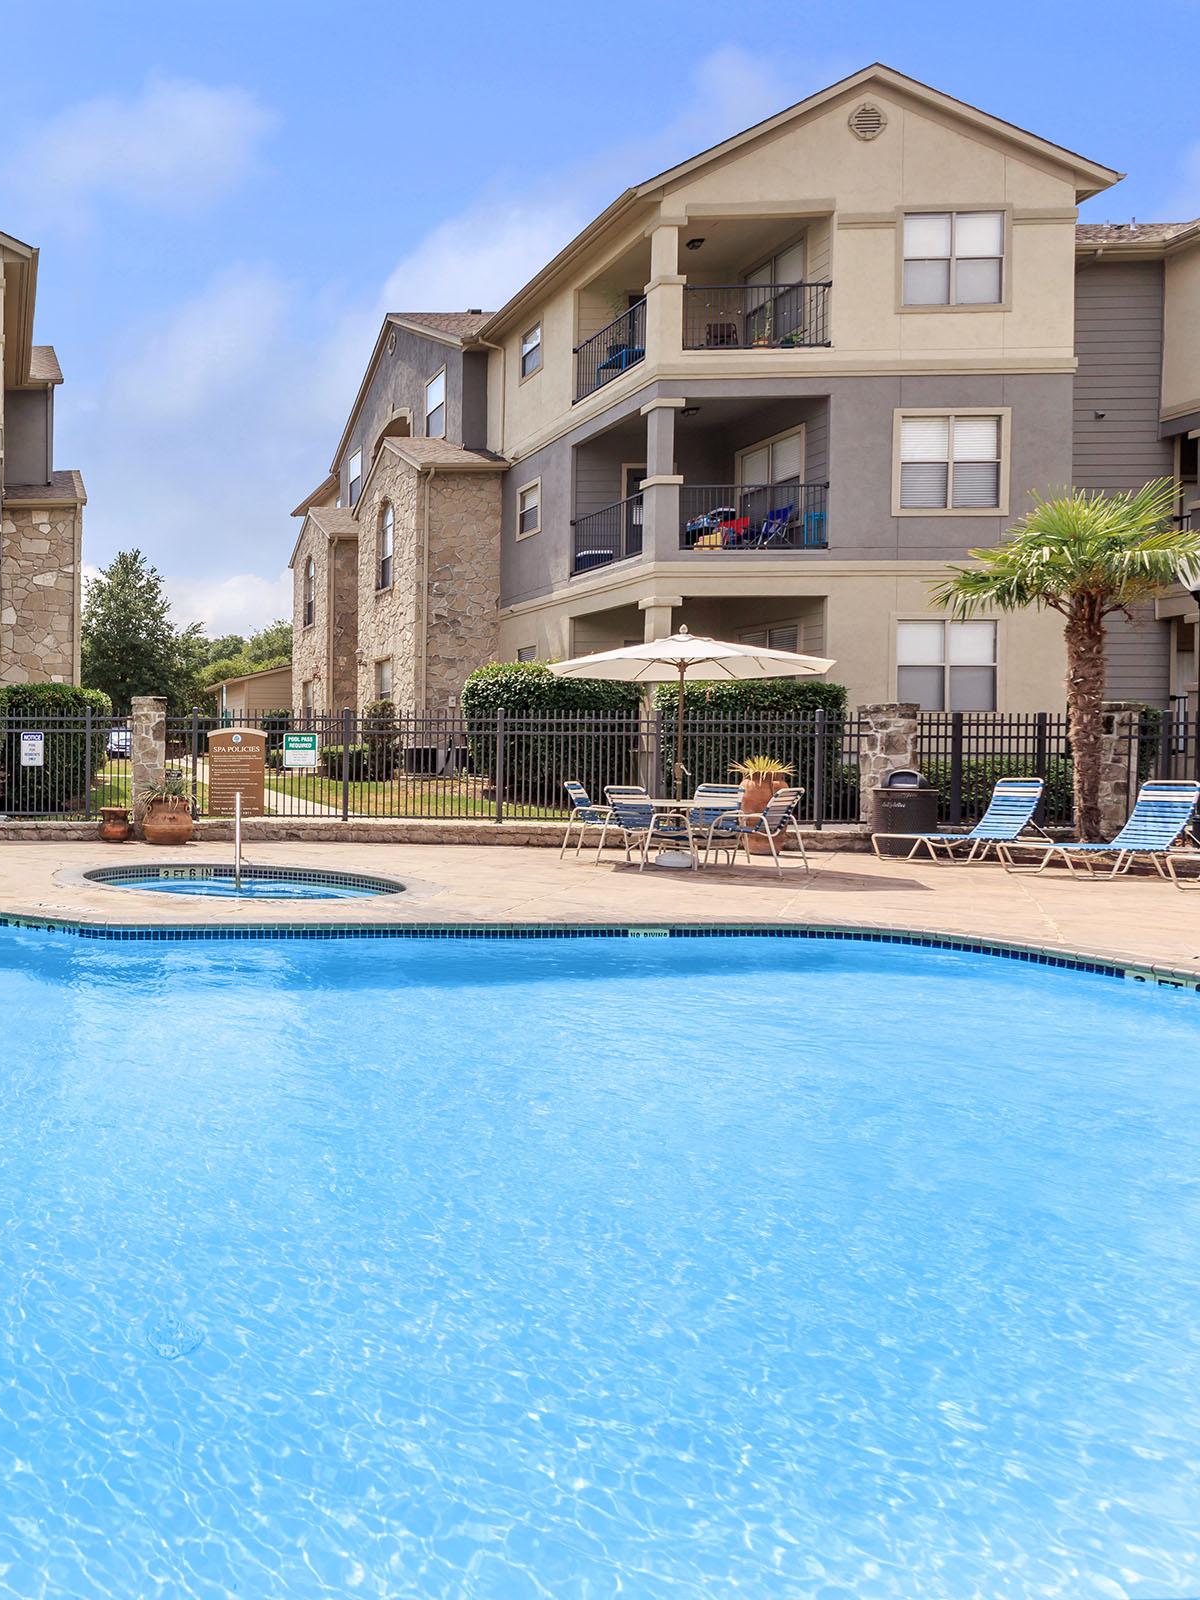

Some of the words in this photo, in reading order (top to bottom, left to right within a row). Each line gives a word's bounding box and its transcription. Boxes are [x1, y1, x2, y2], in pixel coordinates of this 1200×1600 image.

[227, 745, 260, 753] POLICIES
[189, 868, 196, 877] 6
[201, 868, 212, 877] IN
